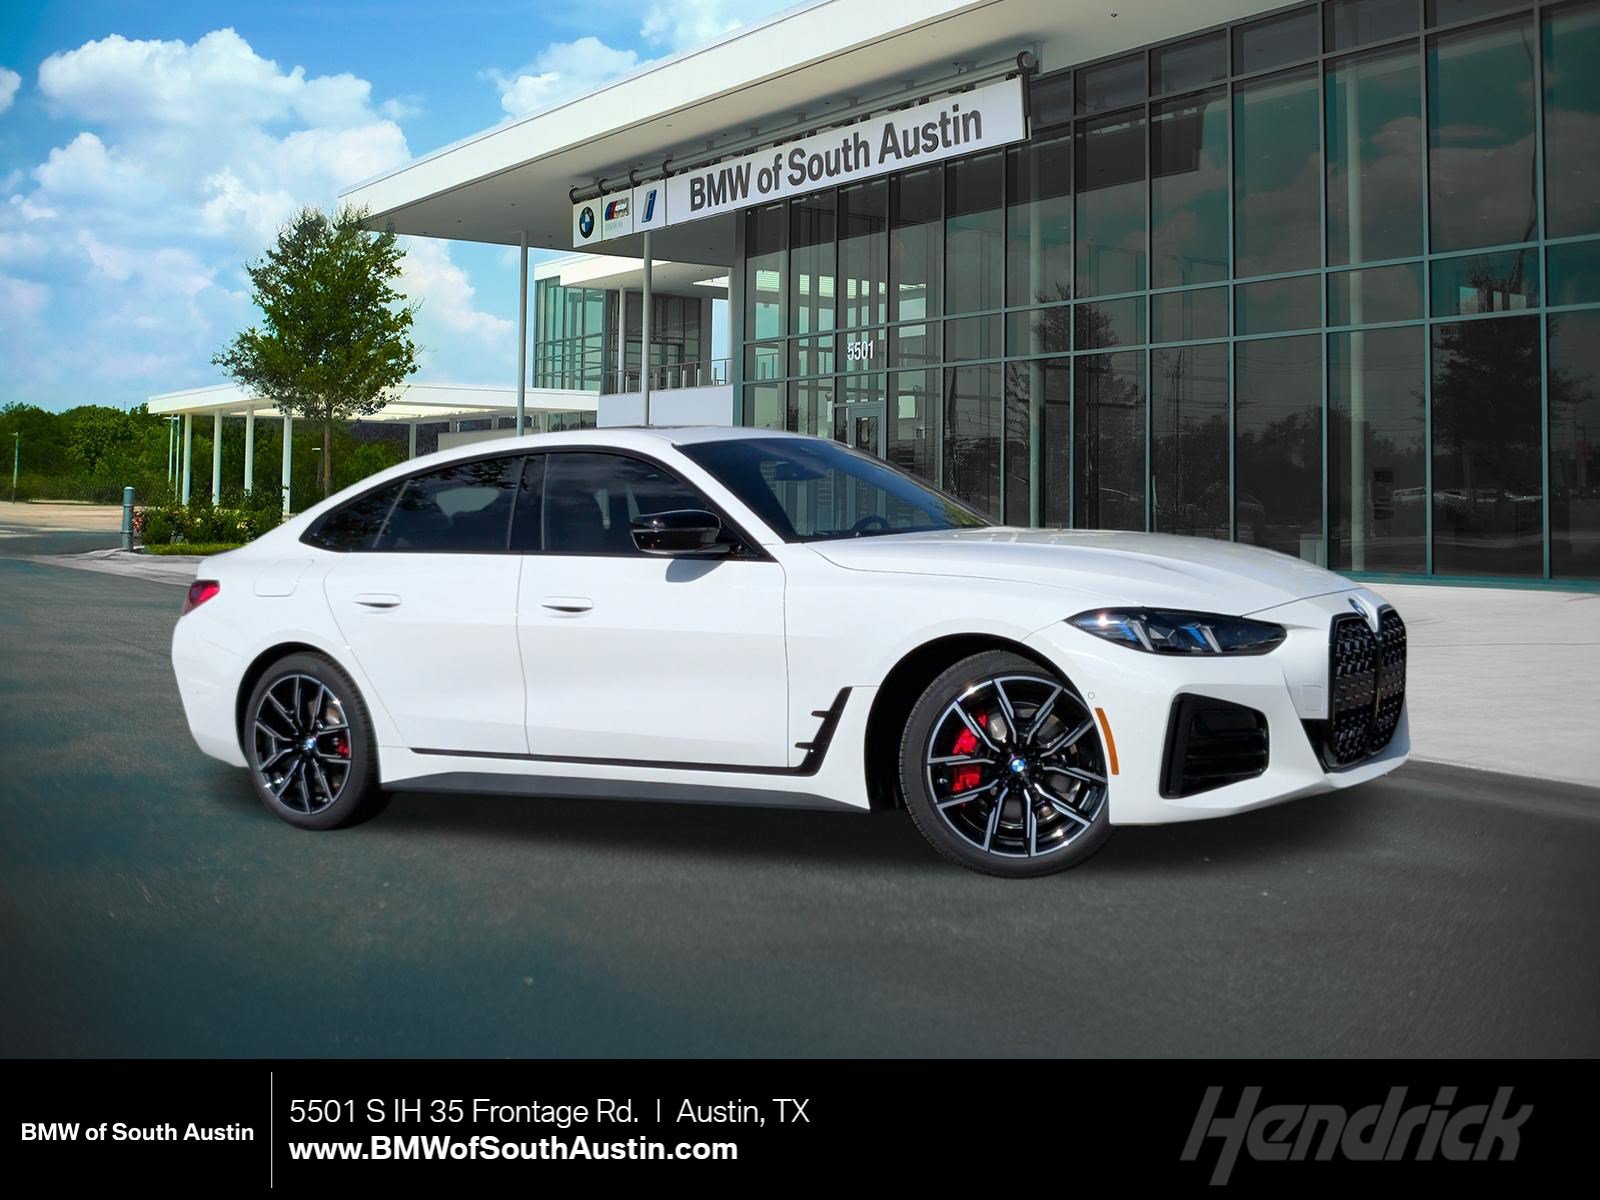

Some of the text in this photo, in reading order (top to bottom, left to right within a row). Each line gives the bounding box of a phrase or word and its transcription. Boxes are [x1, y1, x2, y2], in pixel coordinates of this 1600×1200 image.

[690, 104, 982, 212] BMW of South Austin
[847, 340, 873, 360] 5501
